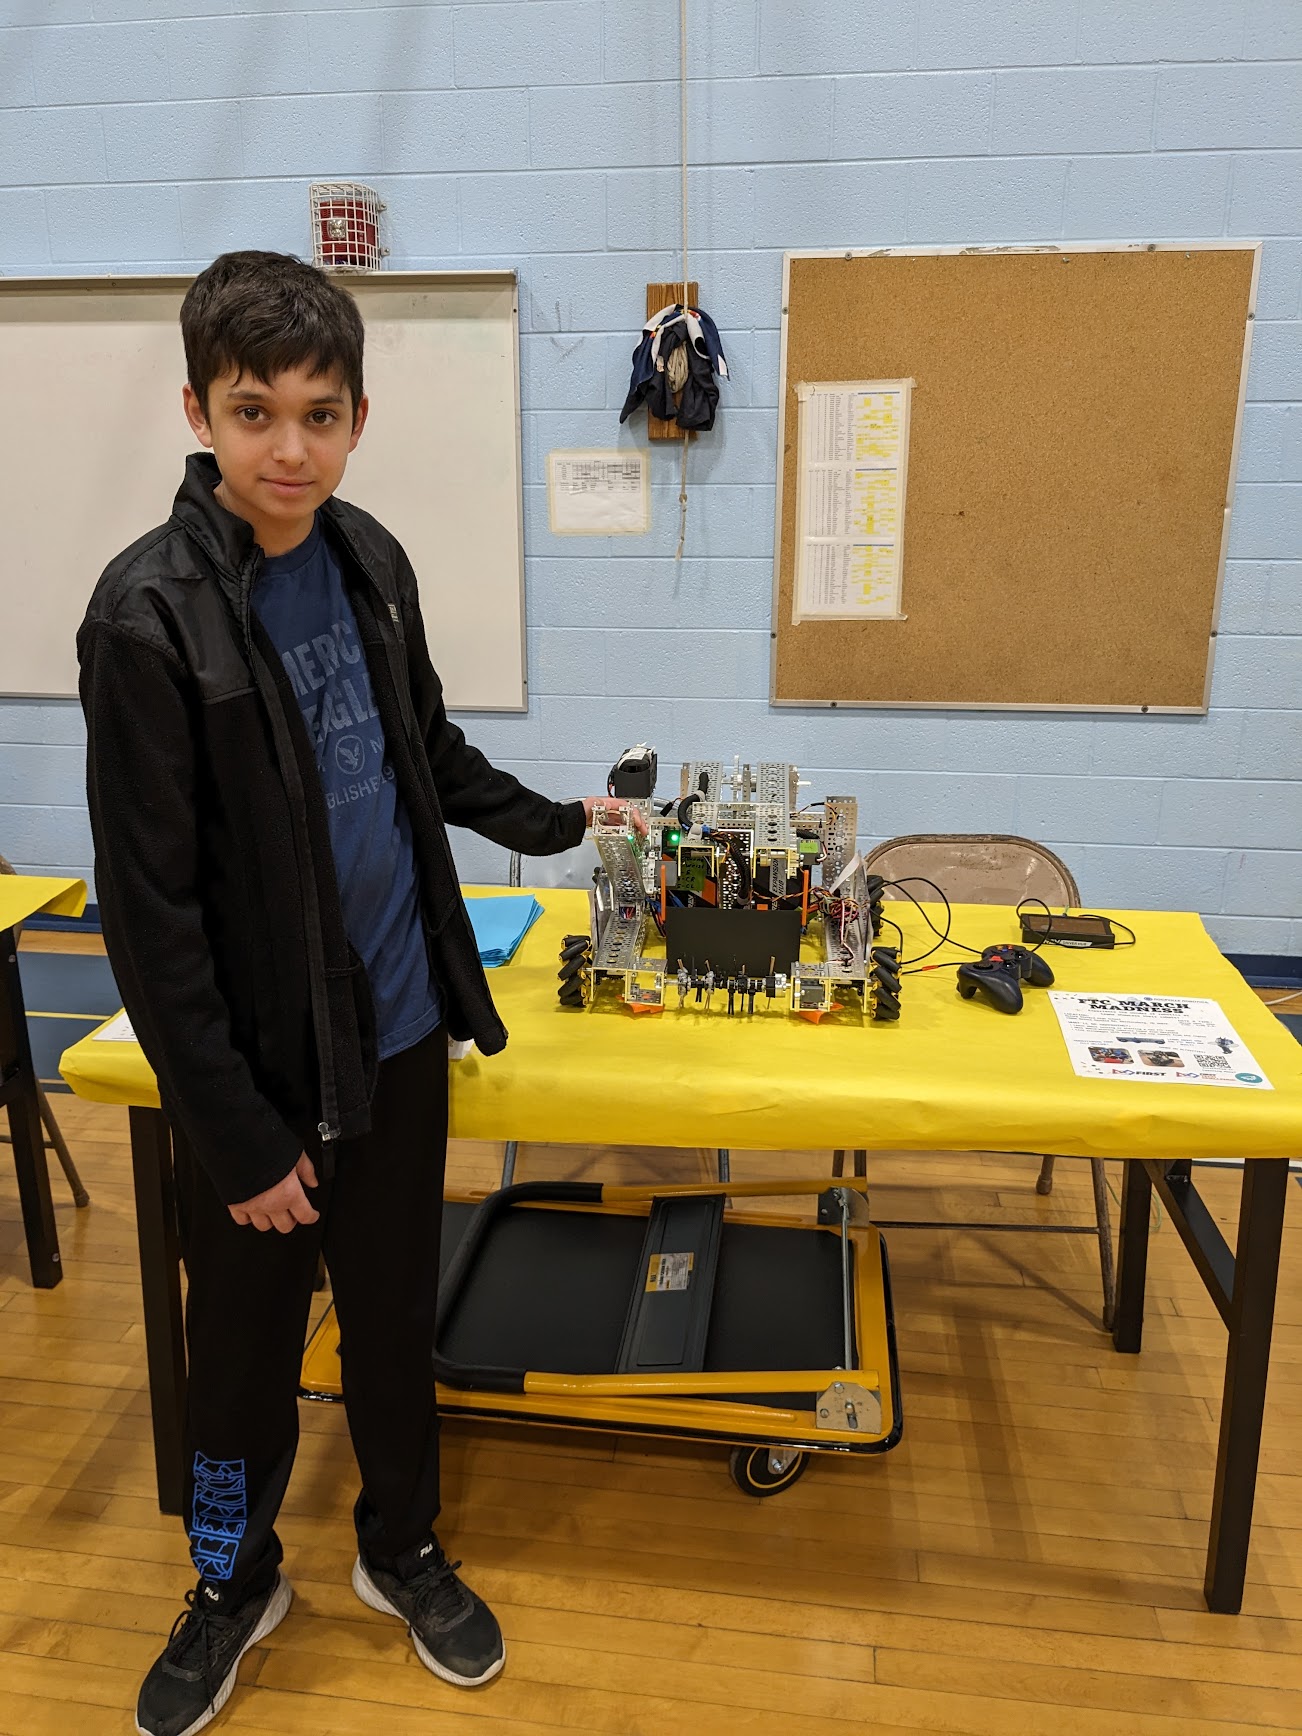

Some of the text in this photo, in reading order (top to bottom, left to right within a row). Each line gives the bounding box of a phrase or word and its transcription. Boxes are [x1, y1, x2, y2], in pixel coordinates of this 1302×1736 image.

[1090, 1004, 1184, 1013] MADNESS
[1118, 1000, 1191, 1009] MARCH
[205, 1586, 219, 1602] FILA
